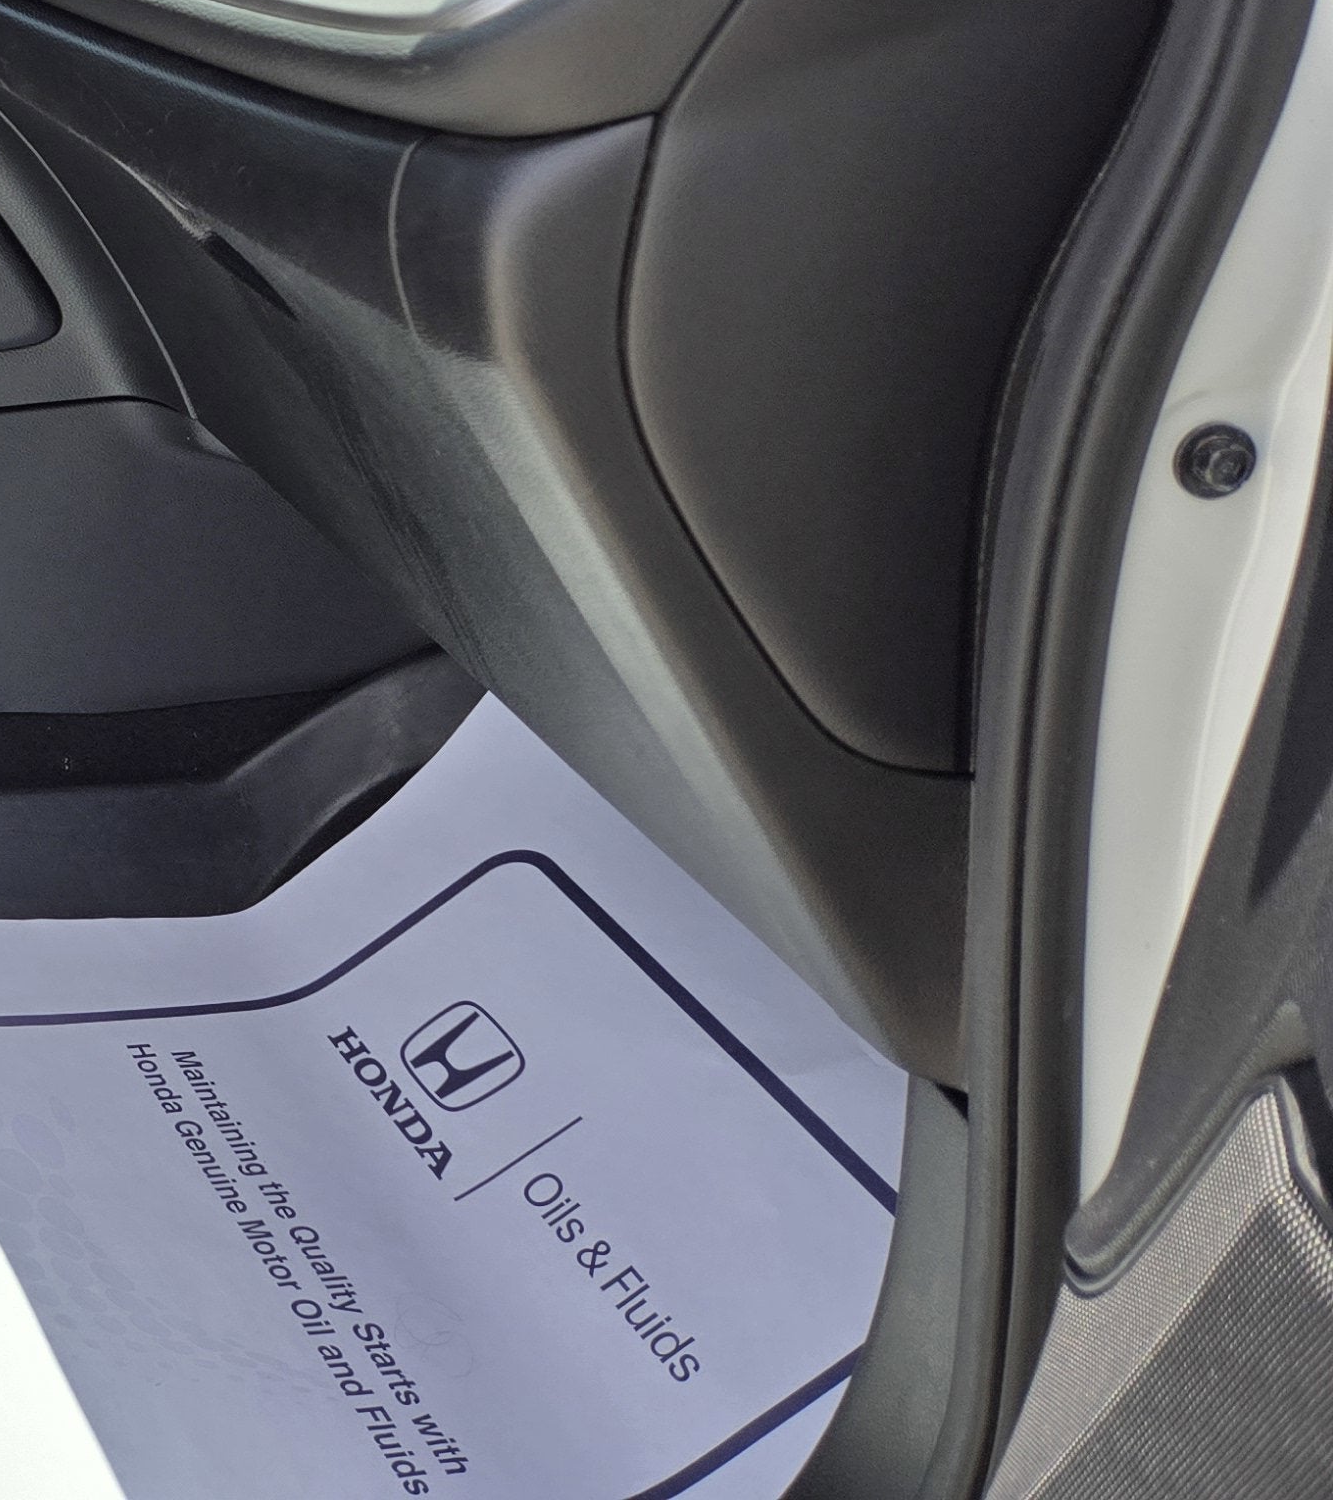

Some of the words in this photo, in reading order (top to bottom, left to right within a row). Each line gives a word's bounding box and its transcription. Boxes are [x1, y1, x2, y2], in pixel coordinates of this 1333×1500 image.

[326, 1025, 453, 1181] HONDA
[126, 1043, 183, 1114] Honda
[174, 1120, 248, 1214] Genuine
[236, 1219, 302, 1290] Motor
[290, 1299, 336, 1336] Oil
[317, 1344, 375, 1397] and
[355, 1405, 430, 1496] Fluids
[170, 1051, 269, 1177] Maintaining
[258, 1181, 297, 1220] the
[289, 1225, 364, 1314] Quality
[352, 1322, 421, 1406] Starts
[411, 1413, 469, 1475] with
[523, 1172, 585, 1243] Oils
[576, 1239, 612, 1279] &
[599, 1265, 701, 1382] Fluids
